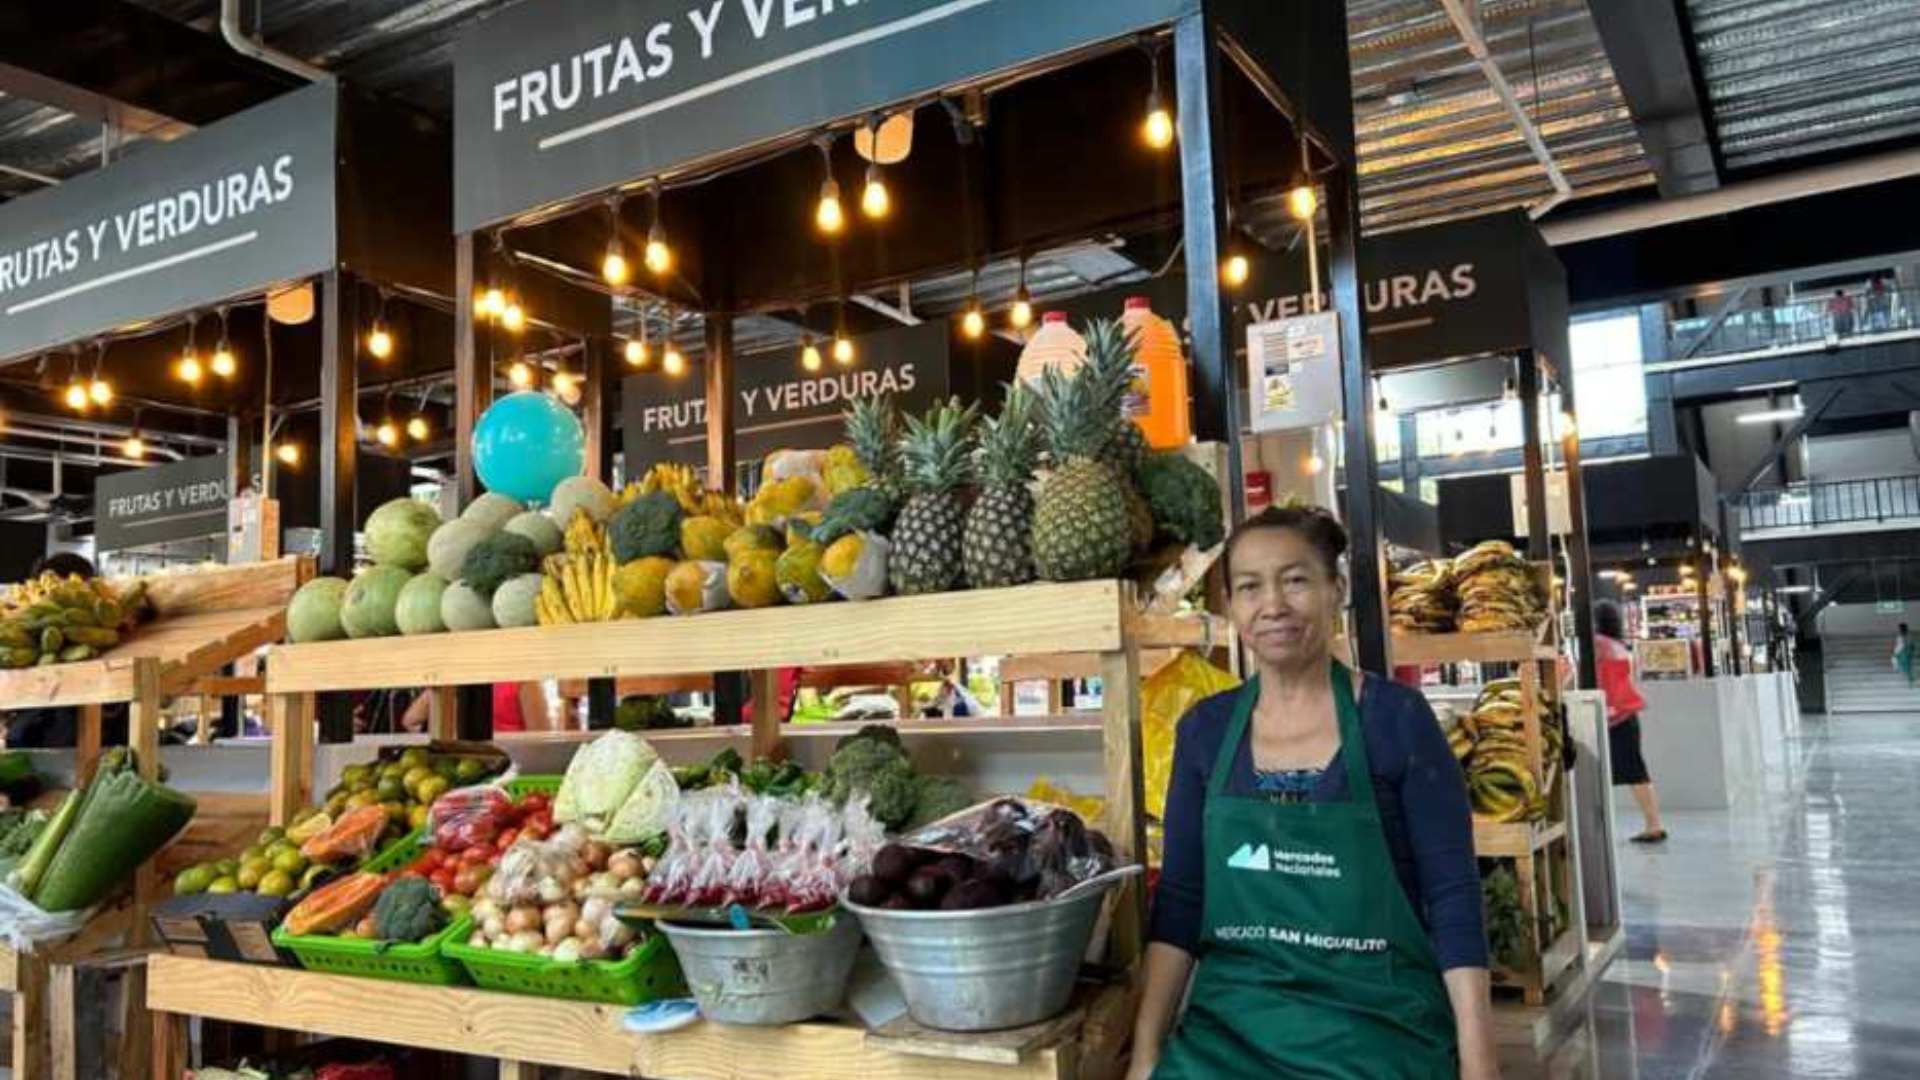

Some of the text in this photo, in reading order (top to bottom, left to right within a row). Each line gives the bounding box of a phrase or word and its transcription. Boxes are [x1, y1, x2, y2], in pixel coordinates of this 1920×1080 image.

[493, 22, 674, 131] FRUTAS
[688, 0, 723, 59] Y
[87, 219, 108, 262] Y
[114, 154, 293, 252] VERDURAS
[642, 363, 917, 433] FRUT Y VERDURAS
[108, 490, 162, 518] FRUTAS
[163, 488, 176, 509] Y
[1268, 926, 1301, 945] SAN
